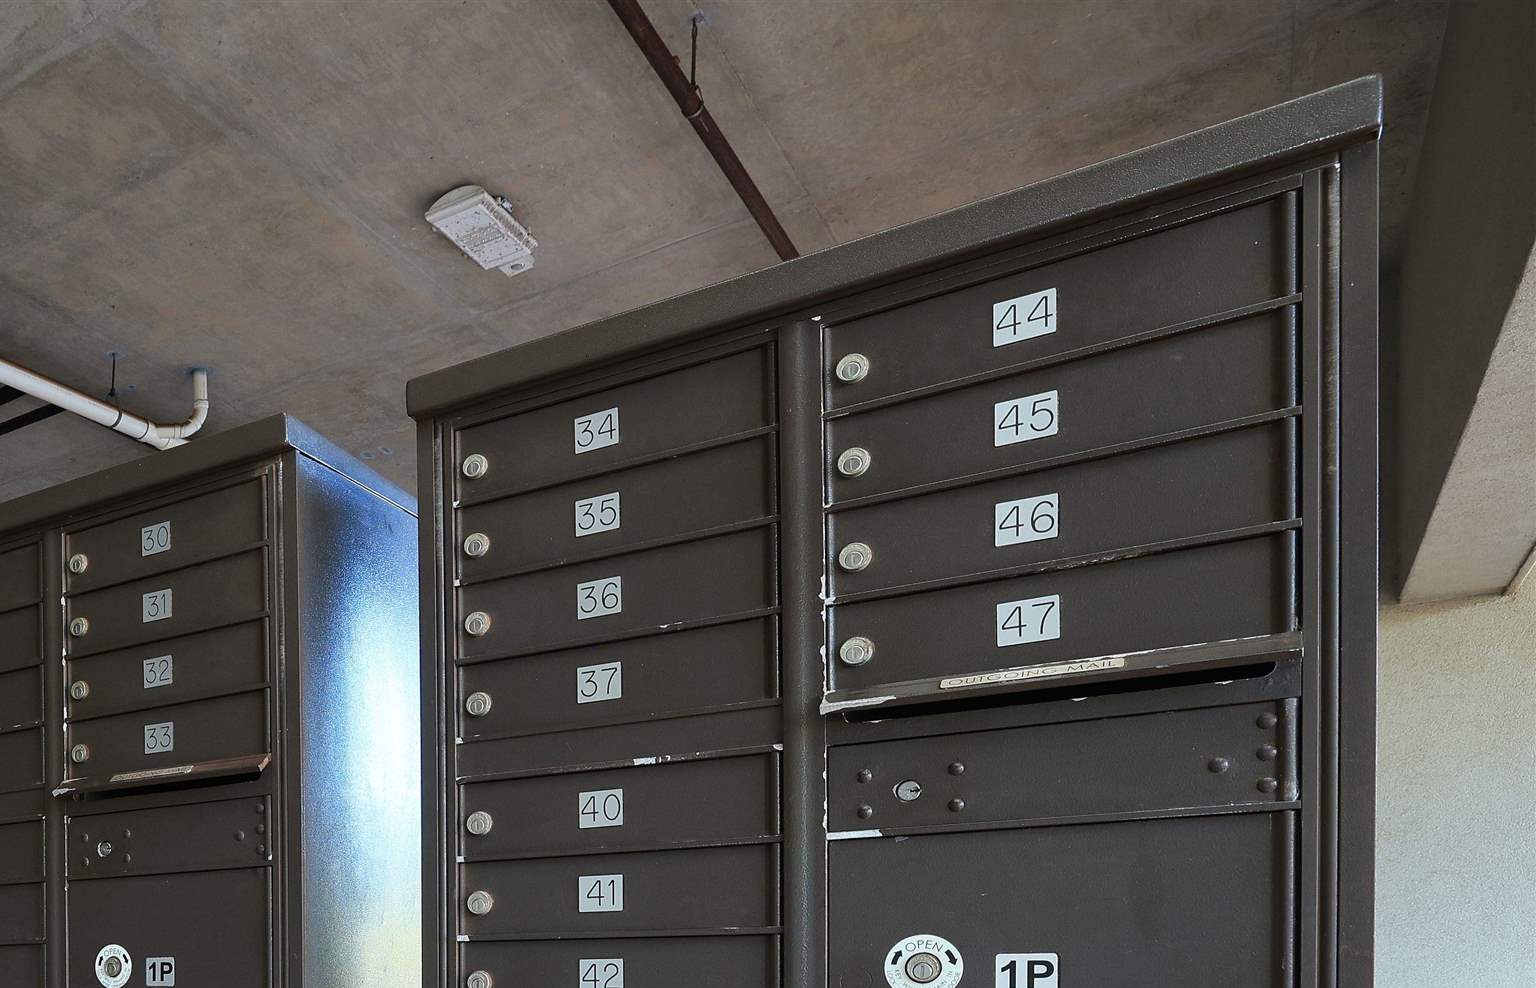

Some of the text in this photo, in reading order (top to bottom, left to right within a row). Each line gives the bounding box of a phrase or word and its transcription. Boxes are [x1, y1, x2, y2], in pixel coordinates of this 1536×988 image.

[996, 295, 1054, 336] 44
[576, 413, 617, 448] 34
[998, 397, 1054, 436] 45
[578, 498, 617, 531] 35
[998, 500, 1055, 537] 46
[143, 525, 169, 552] 30
[147, 593, 166, 618] 31
[580, 582, 619, 614] 36
[1001, 601, 1055, 638] 47
[145, 659, 170, 684] 32
[580, 667, 618, 698] 37
[948, 660, 1116, 686] OUTGOING MAIL
[146, 725, 171, 750] 33
[581, 793, 621, 822] 40
[586, 879, 615, 906] 41
[103, 947, 122, 957] OPEN
[905, 939, 944, 953] OPEN
[148, 961, 173, 982] 1P
